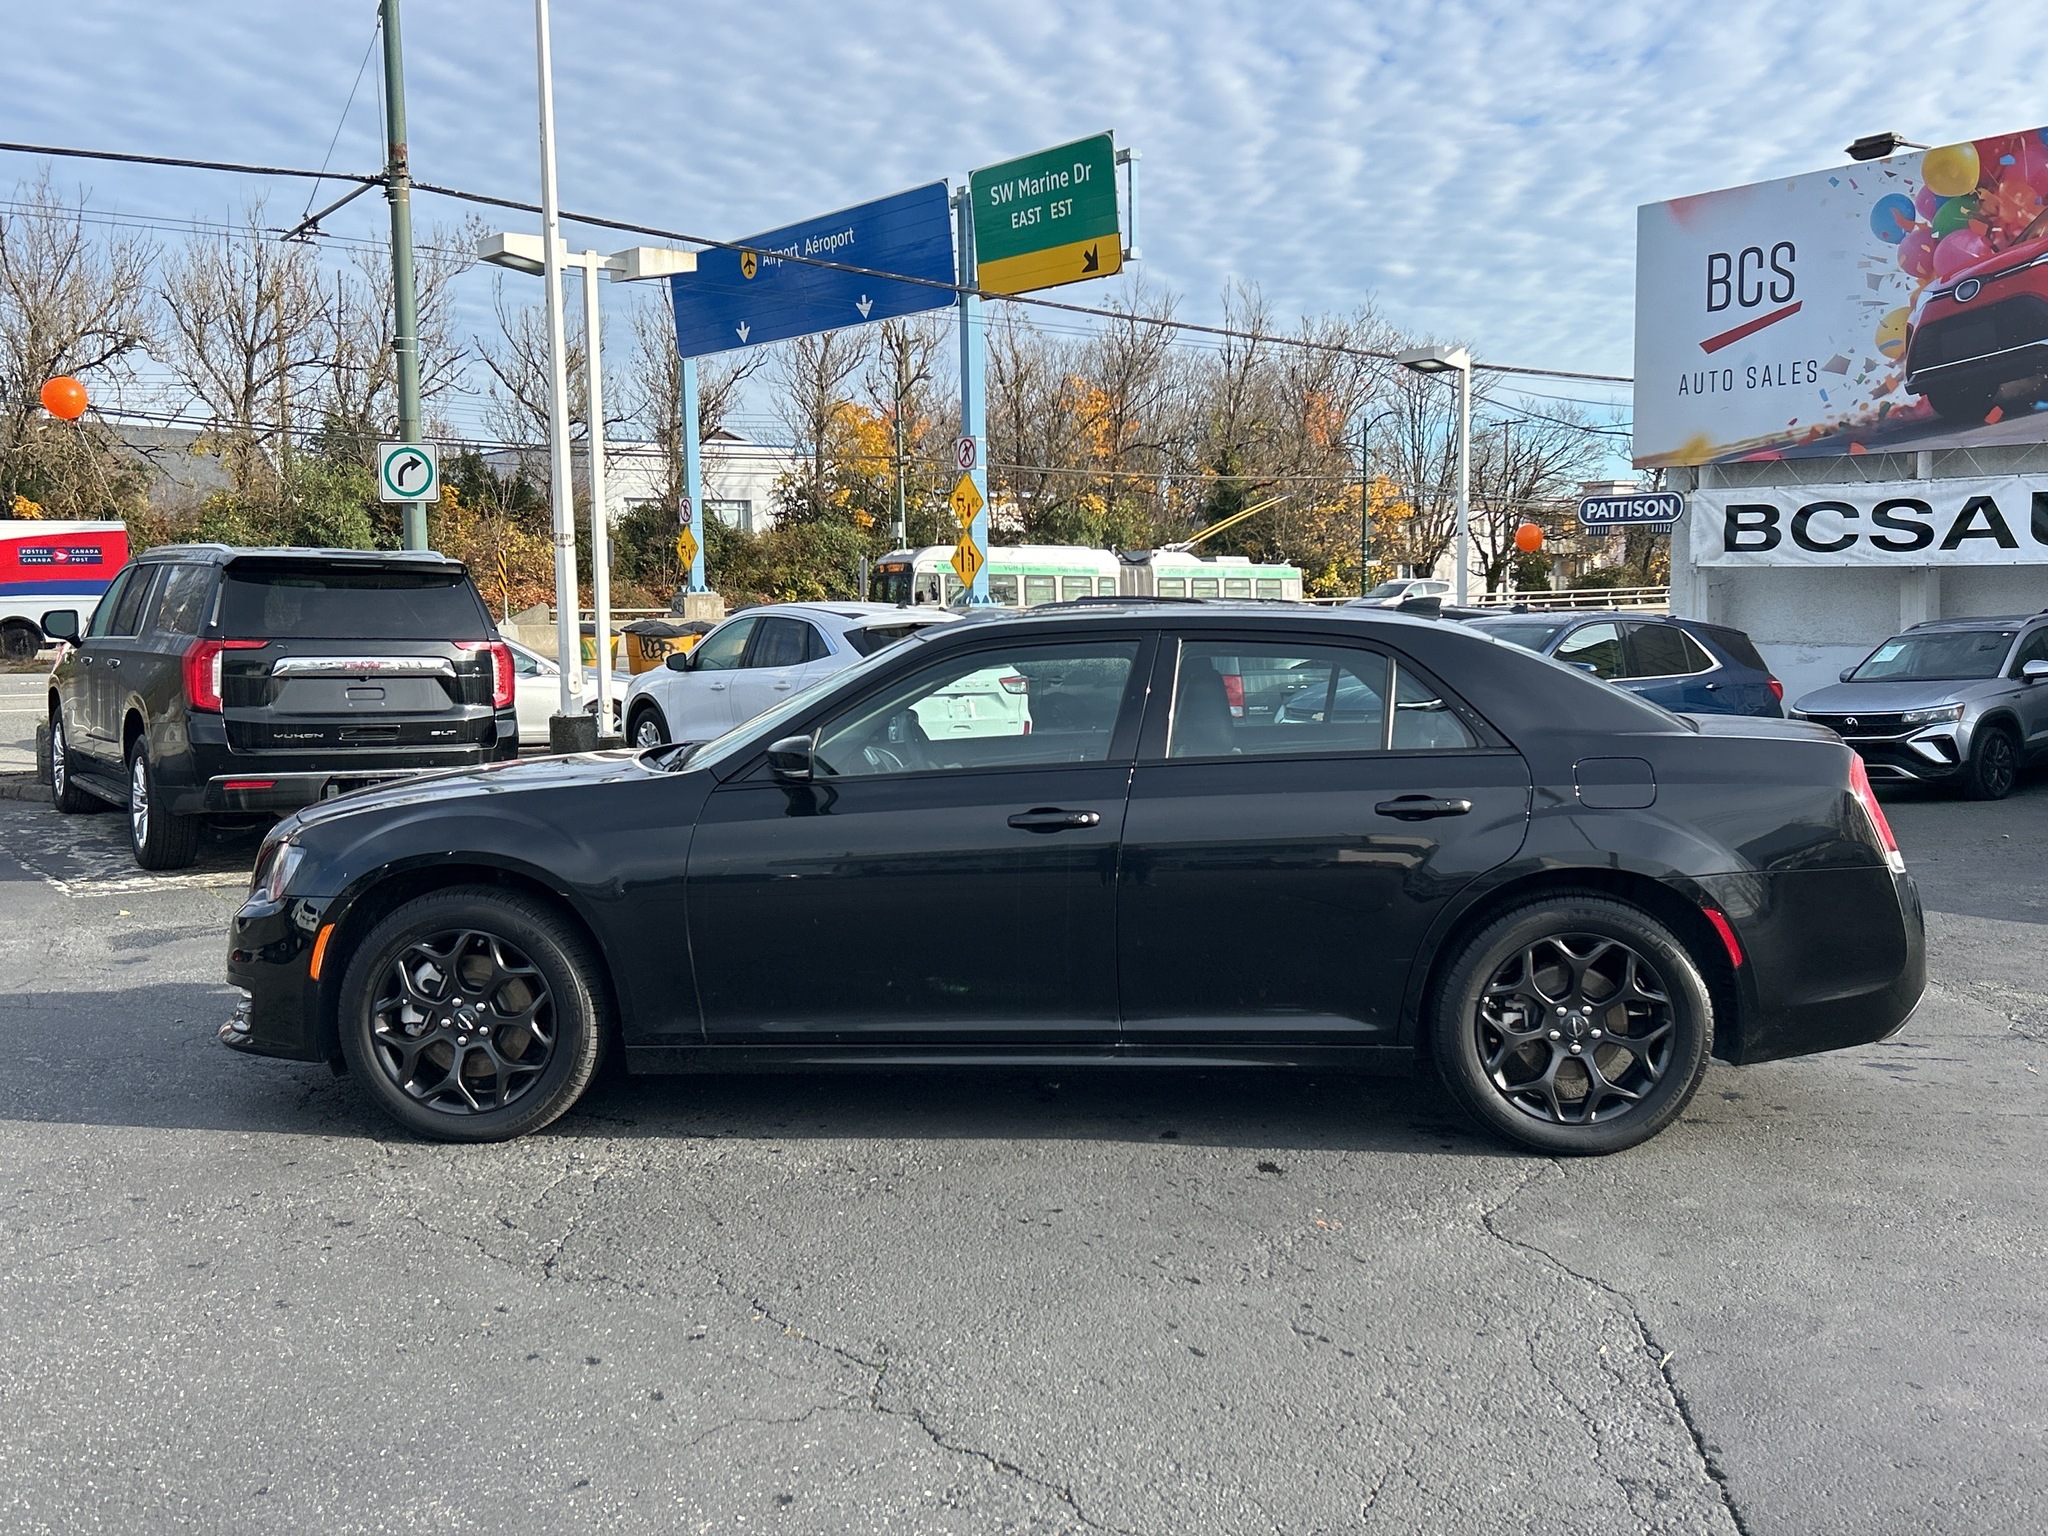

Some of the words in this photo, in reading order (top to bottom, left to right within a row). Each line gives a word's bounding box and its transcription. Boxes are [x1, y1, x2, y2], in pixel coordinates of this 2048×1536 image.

[990, 181, 1014, 206] SW
[1018, 170, 1069, 199] Marine
[1073, 162, 1092, 184] Dr
[1011, 206, 1042, 229] EAST
[1050, 198, 1073, 219] EST
[804, 227, 855, 256] Aéroport
[1706, 241, 1796, 313] BCS
[1678, 368, 1733, 396] AUTO
[1746, 359, 1818, 389] SALES
[1586, 499, 1675, 519] PATTISON
[1724, 492, 2048, 553] BCSA
